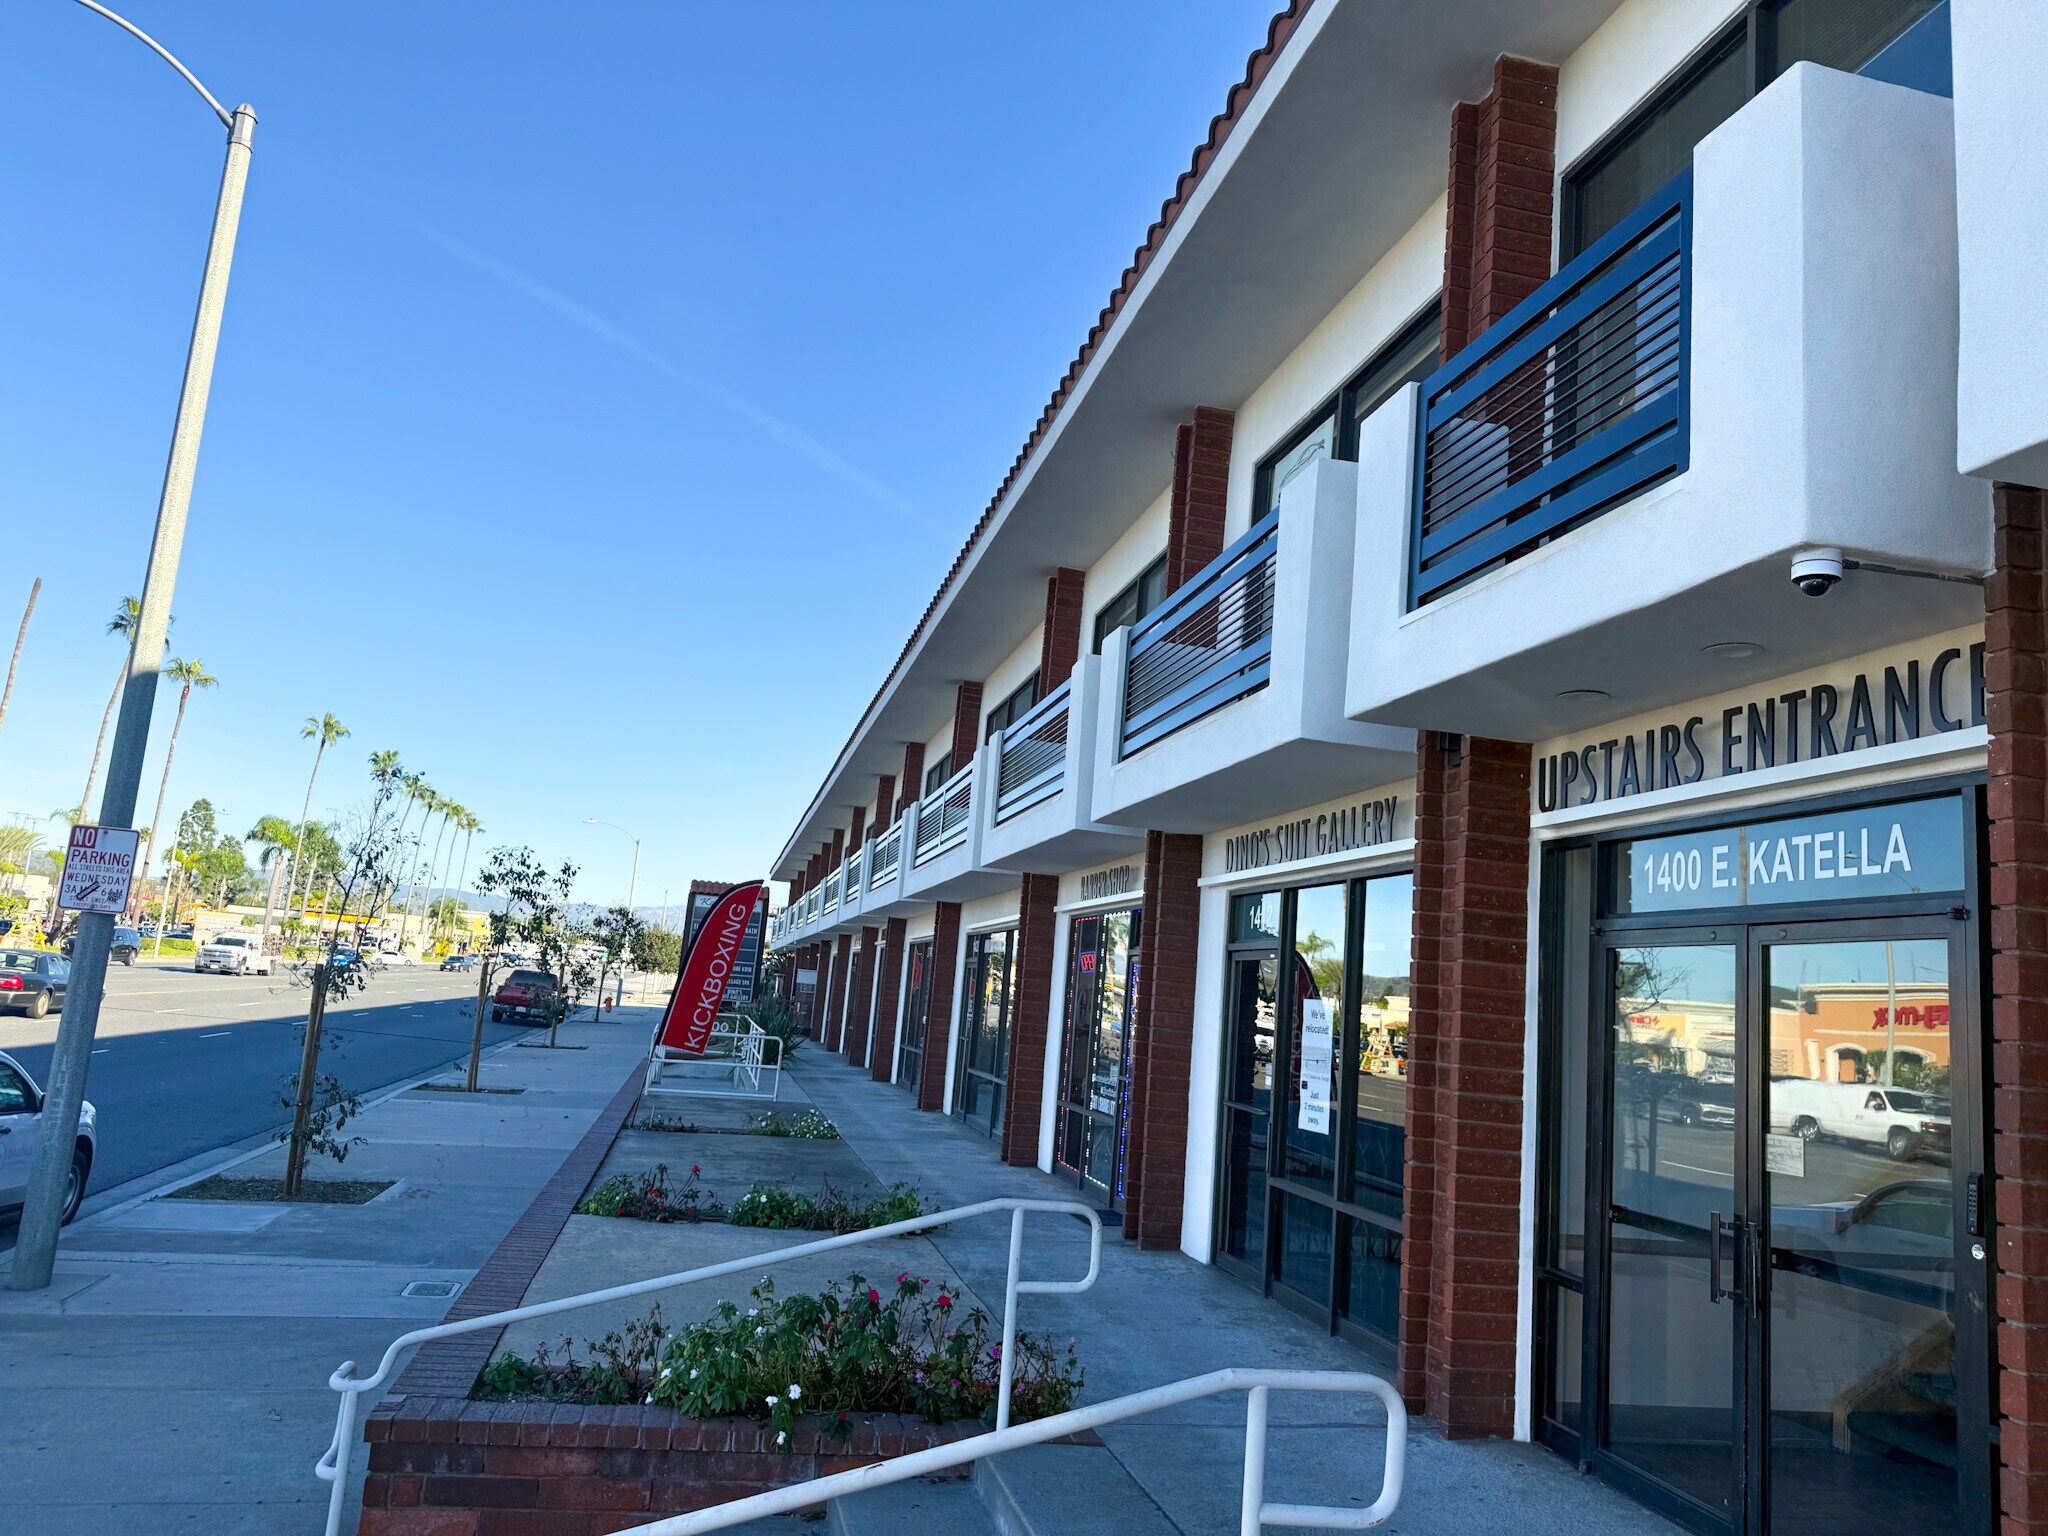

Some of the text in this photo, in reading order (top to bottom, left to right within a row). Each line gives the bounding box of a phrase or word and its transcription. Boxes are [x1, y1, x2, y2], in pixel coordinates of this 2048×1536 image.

[1538, 716, 1704, 812] UPSTAIRS
[73, 827, 95, 846] NO
[1226, 795, 1398, 873] DINO'S SUIT GALLERY
[71, 849, 131, 868] PARKING
[1643, 822, 1912, 895] 1400 E. KATELLA
[67, 872, 128, 886] WEDNESDAY
[80, 864, 101, 872] STREETS
[103, 866, 115, 874] THIS
[116, 867, 130, 875] AREA
[1080, 865, 1130, 902] BARBER SHOP
[683, 903, 746, 1049] KICKBOXING
[1310, 1009, 1326, 1020] We've
[1305, 1024, 1330, 1036] relocated!
[1309, 1090, 1319, 1100] Just
[1307, 1103, 1325, 1114] minutes
